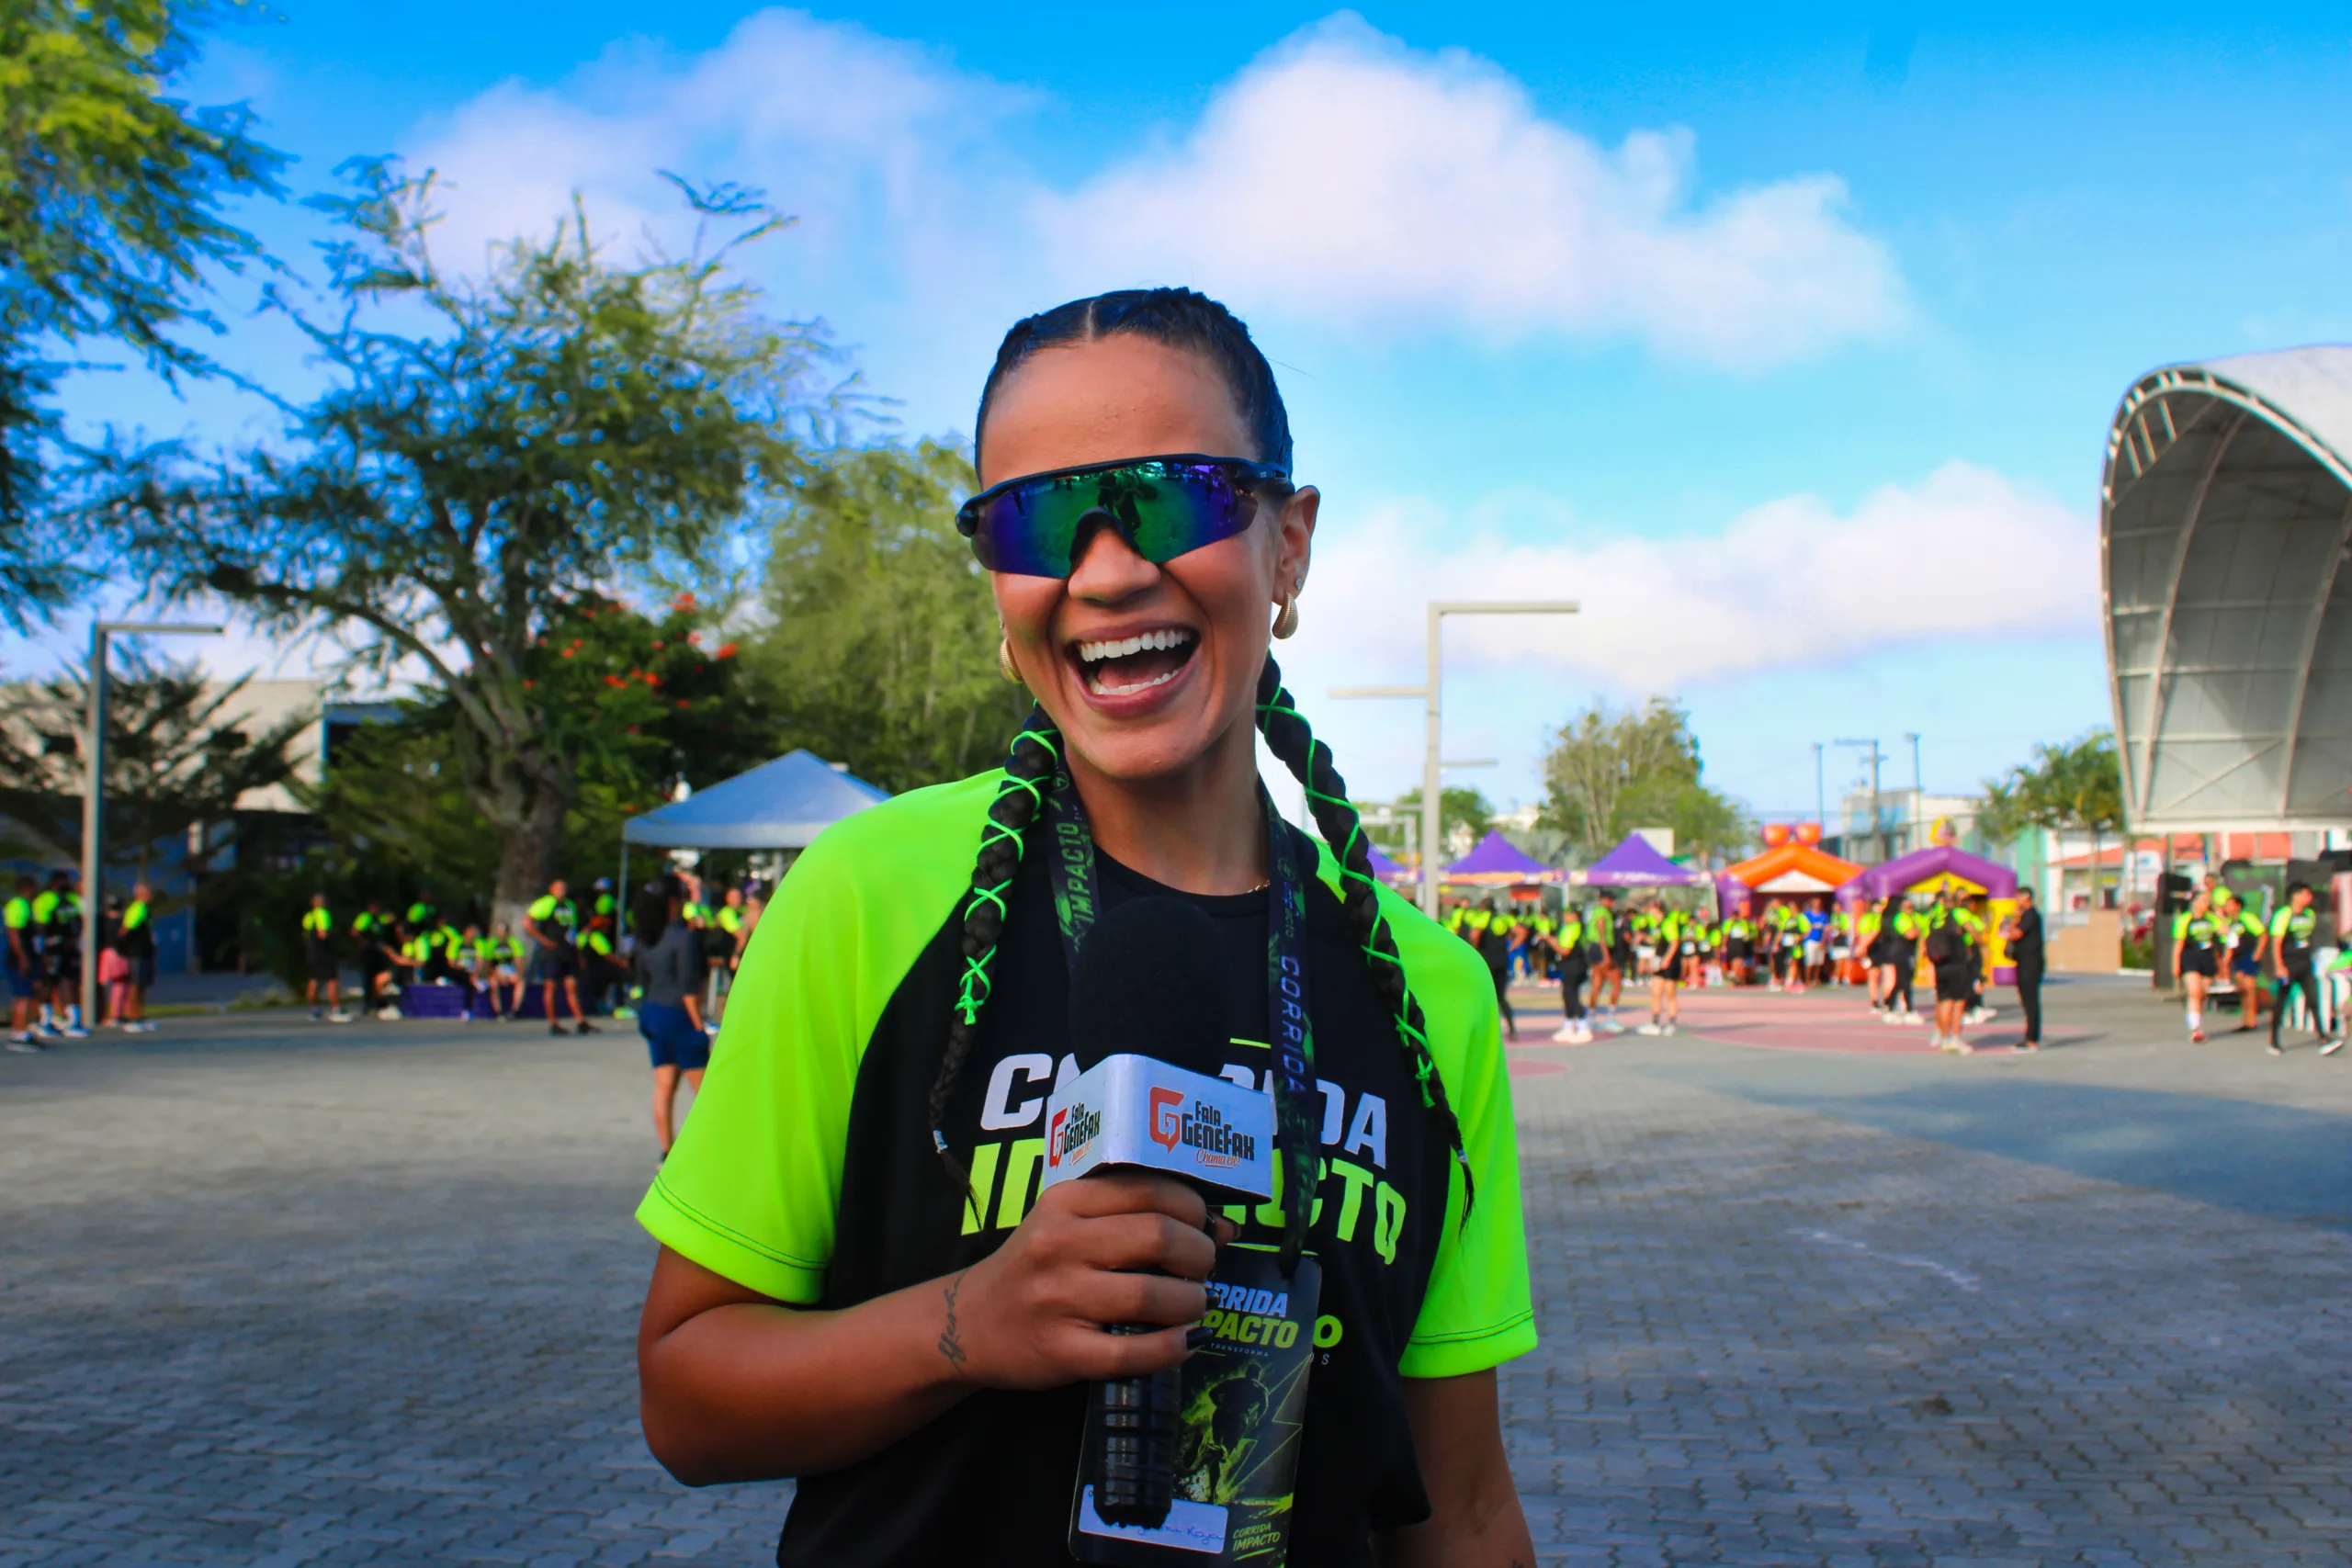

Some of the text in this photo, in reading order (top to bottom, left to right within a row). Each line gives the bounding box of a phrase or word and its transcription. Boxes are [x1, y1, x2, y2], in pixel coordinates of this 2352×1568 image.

[1056, 823, 1095, 922] IMPACTO
[1280, 954, 1306, 1093] CORRIDA
[1195, 1148, 1226, 1166] Chama
[1193, 1308, 1299, 1349] PACTO
[1210, 1342, 1270, 1358] TRANSFORMA
[1233, 1522, 1272, 1539] CORRIDA
[1232, 1531, 1281, 1551] IMPACTO
